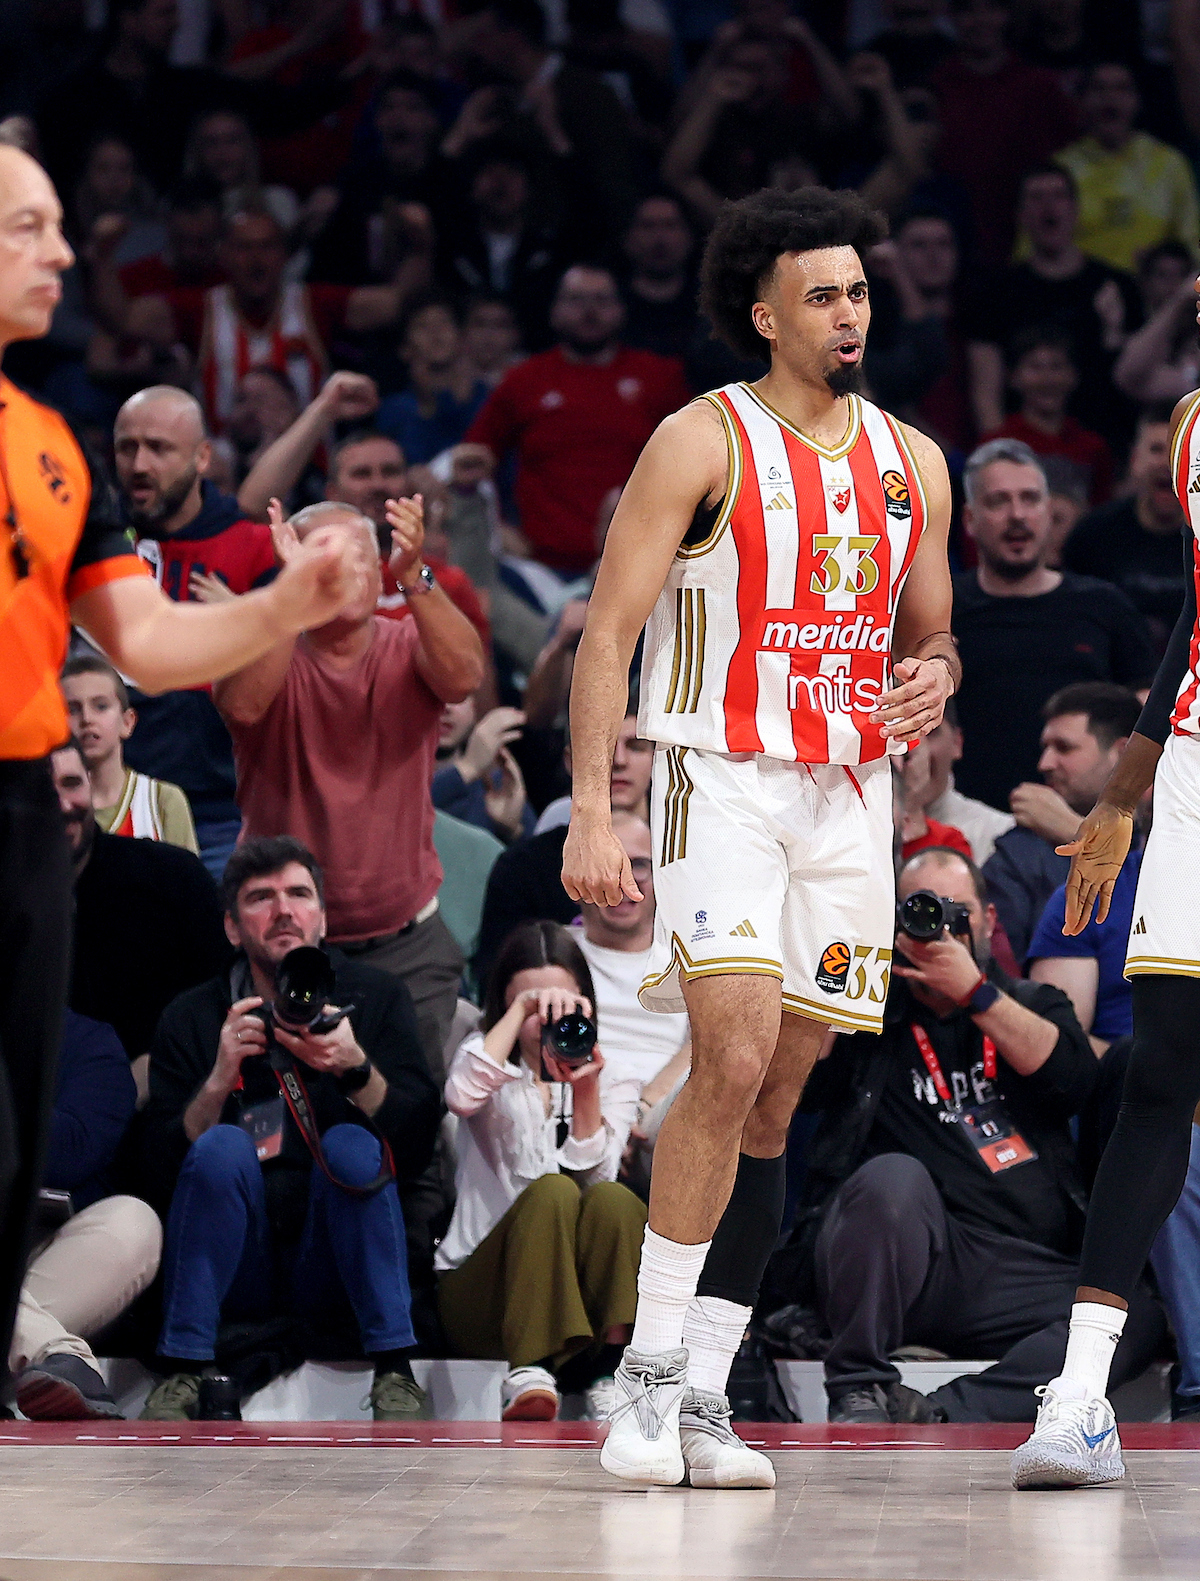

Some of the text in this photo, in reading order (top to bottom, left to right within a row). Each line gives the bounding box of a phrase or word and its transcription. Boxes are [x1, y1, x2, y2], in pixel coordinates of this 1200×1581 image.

[808, 533, 881, 596] 33
[788, 666, 882, 714] mts
[845, 944, 893, 1004] 33
